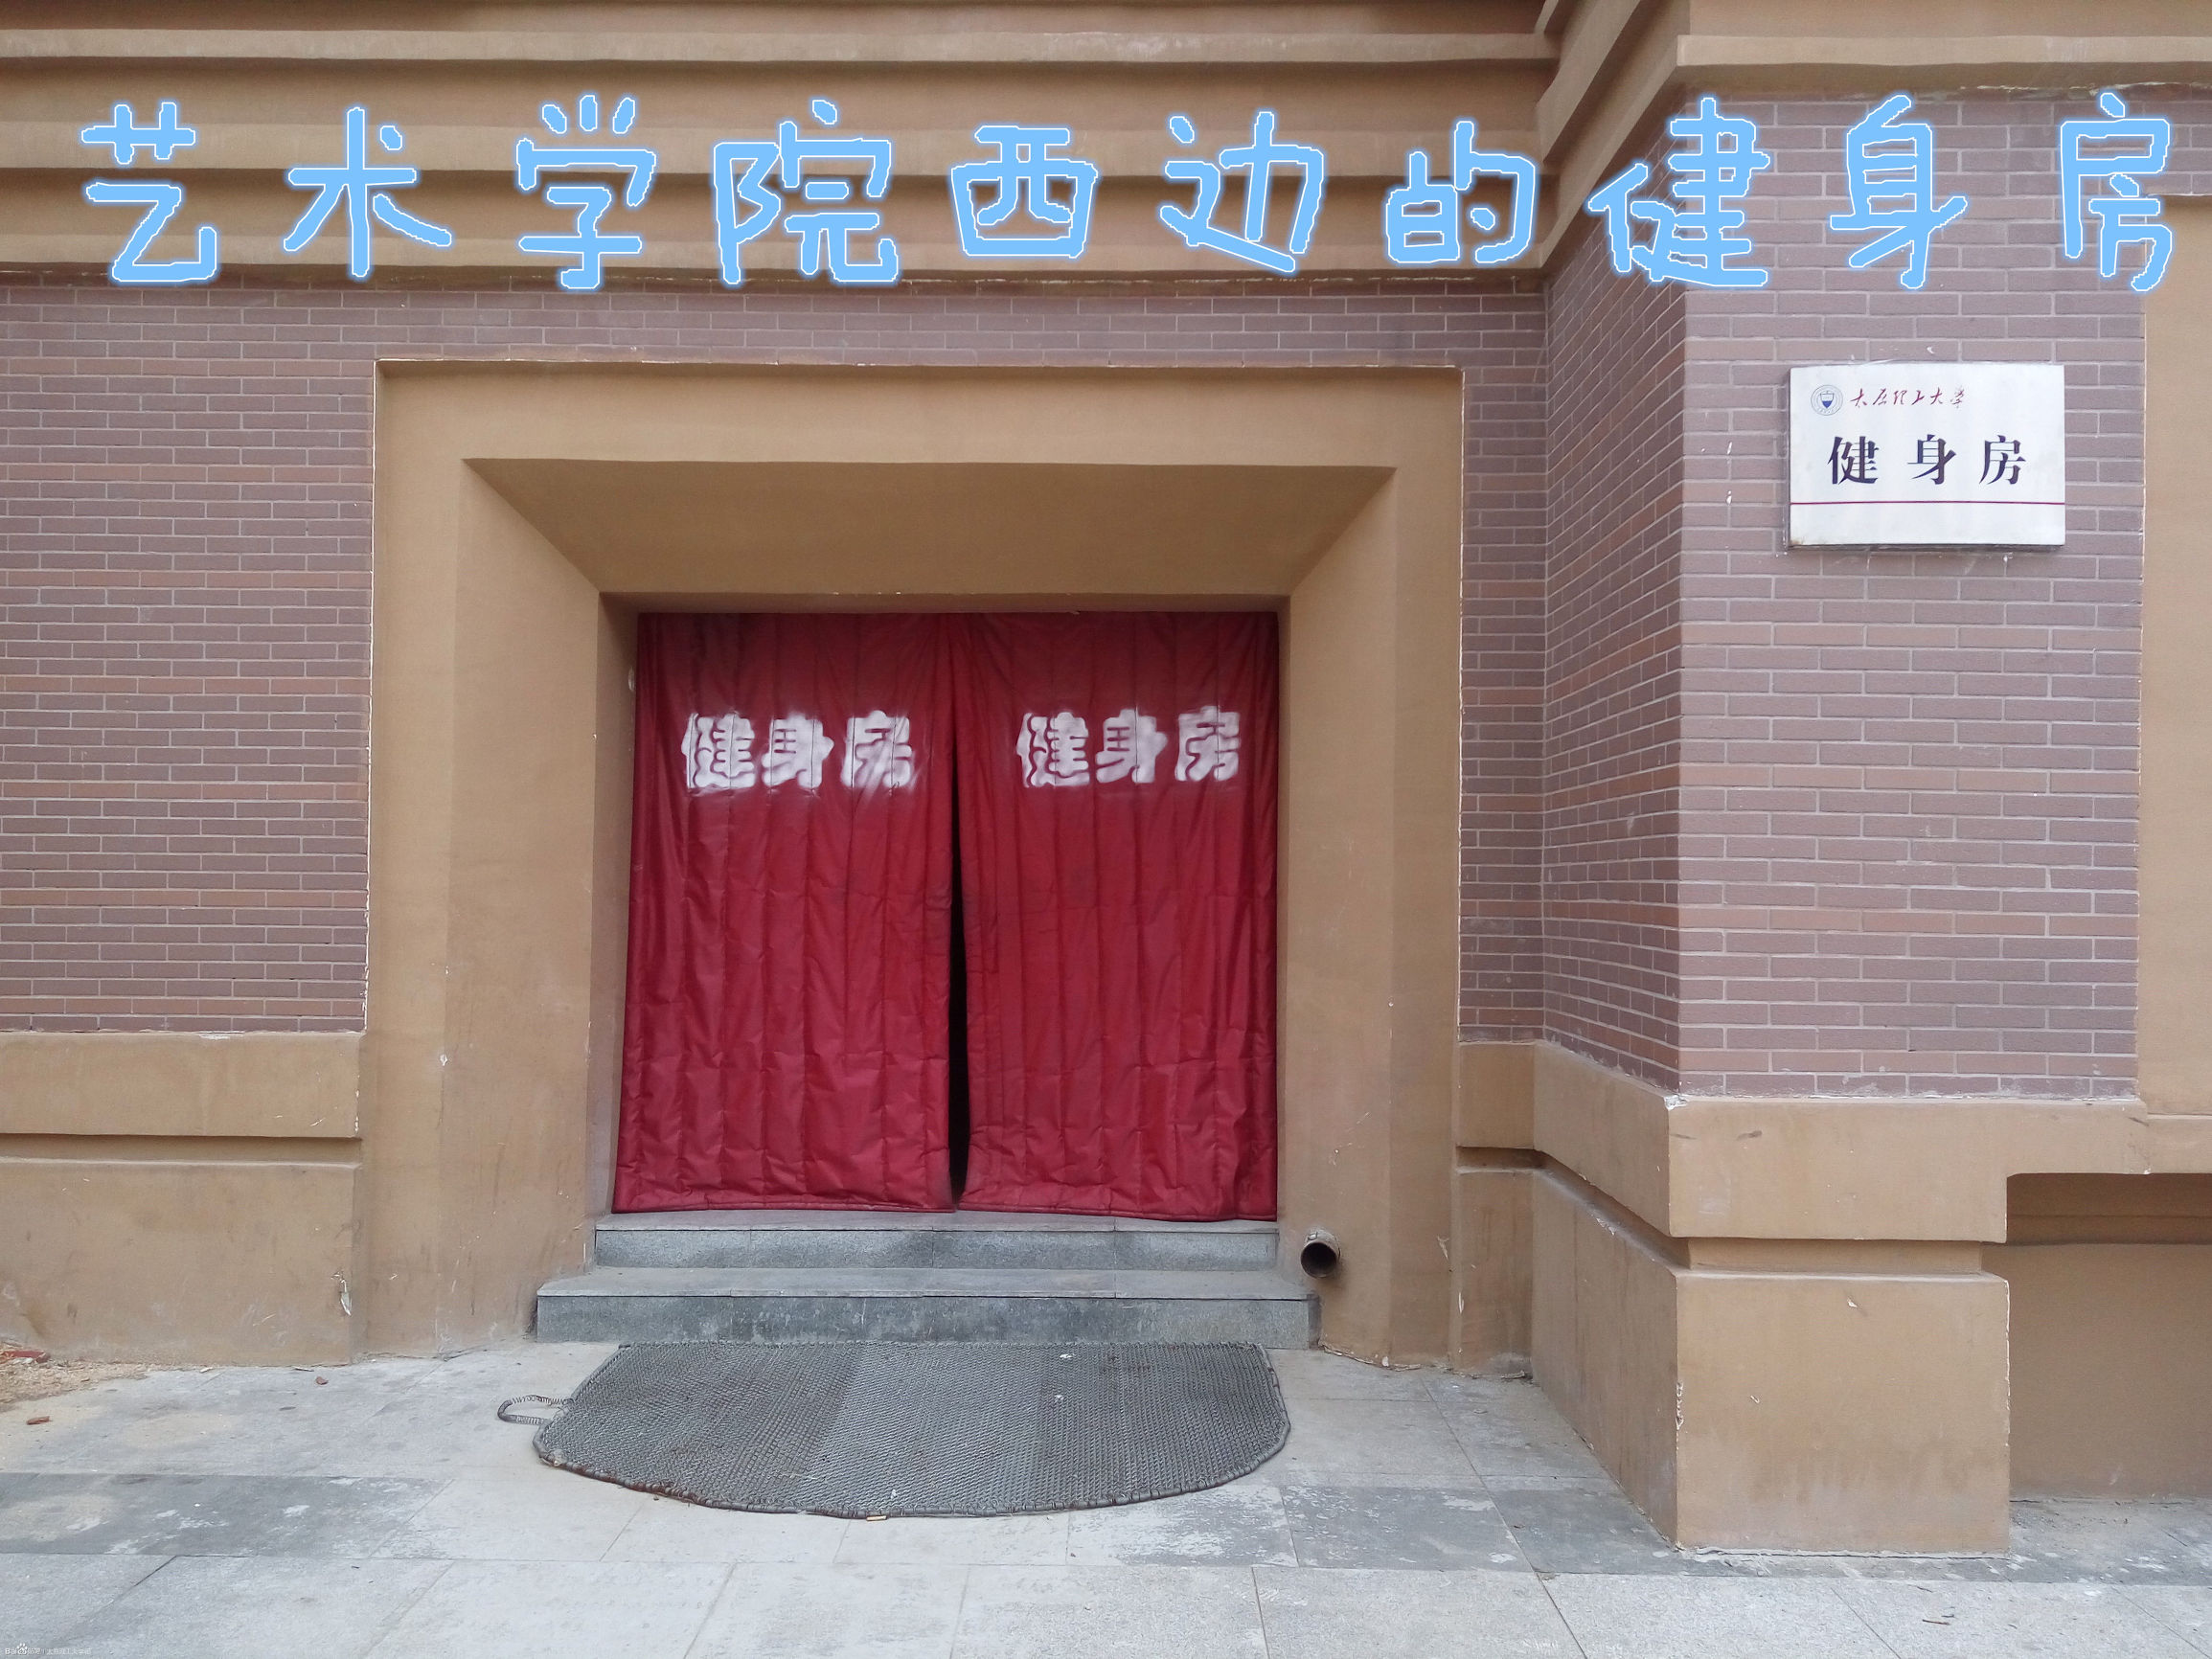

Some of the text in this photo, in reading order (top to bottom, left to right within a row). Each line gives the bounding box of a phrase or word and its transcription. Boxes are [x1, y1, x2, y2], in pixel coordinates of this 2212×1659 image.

[1850, 387, 1971, 409] 太原理工大学
[1826, 433, 2026, 486] 健身房
[681, 711, 918, 796] 健身房
[1017, 706, 1240, 788] 健身房
